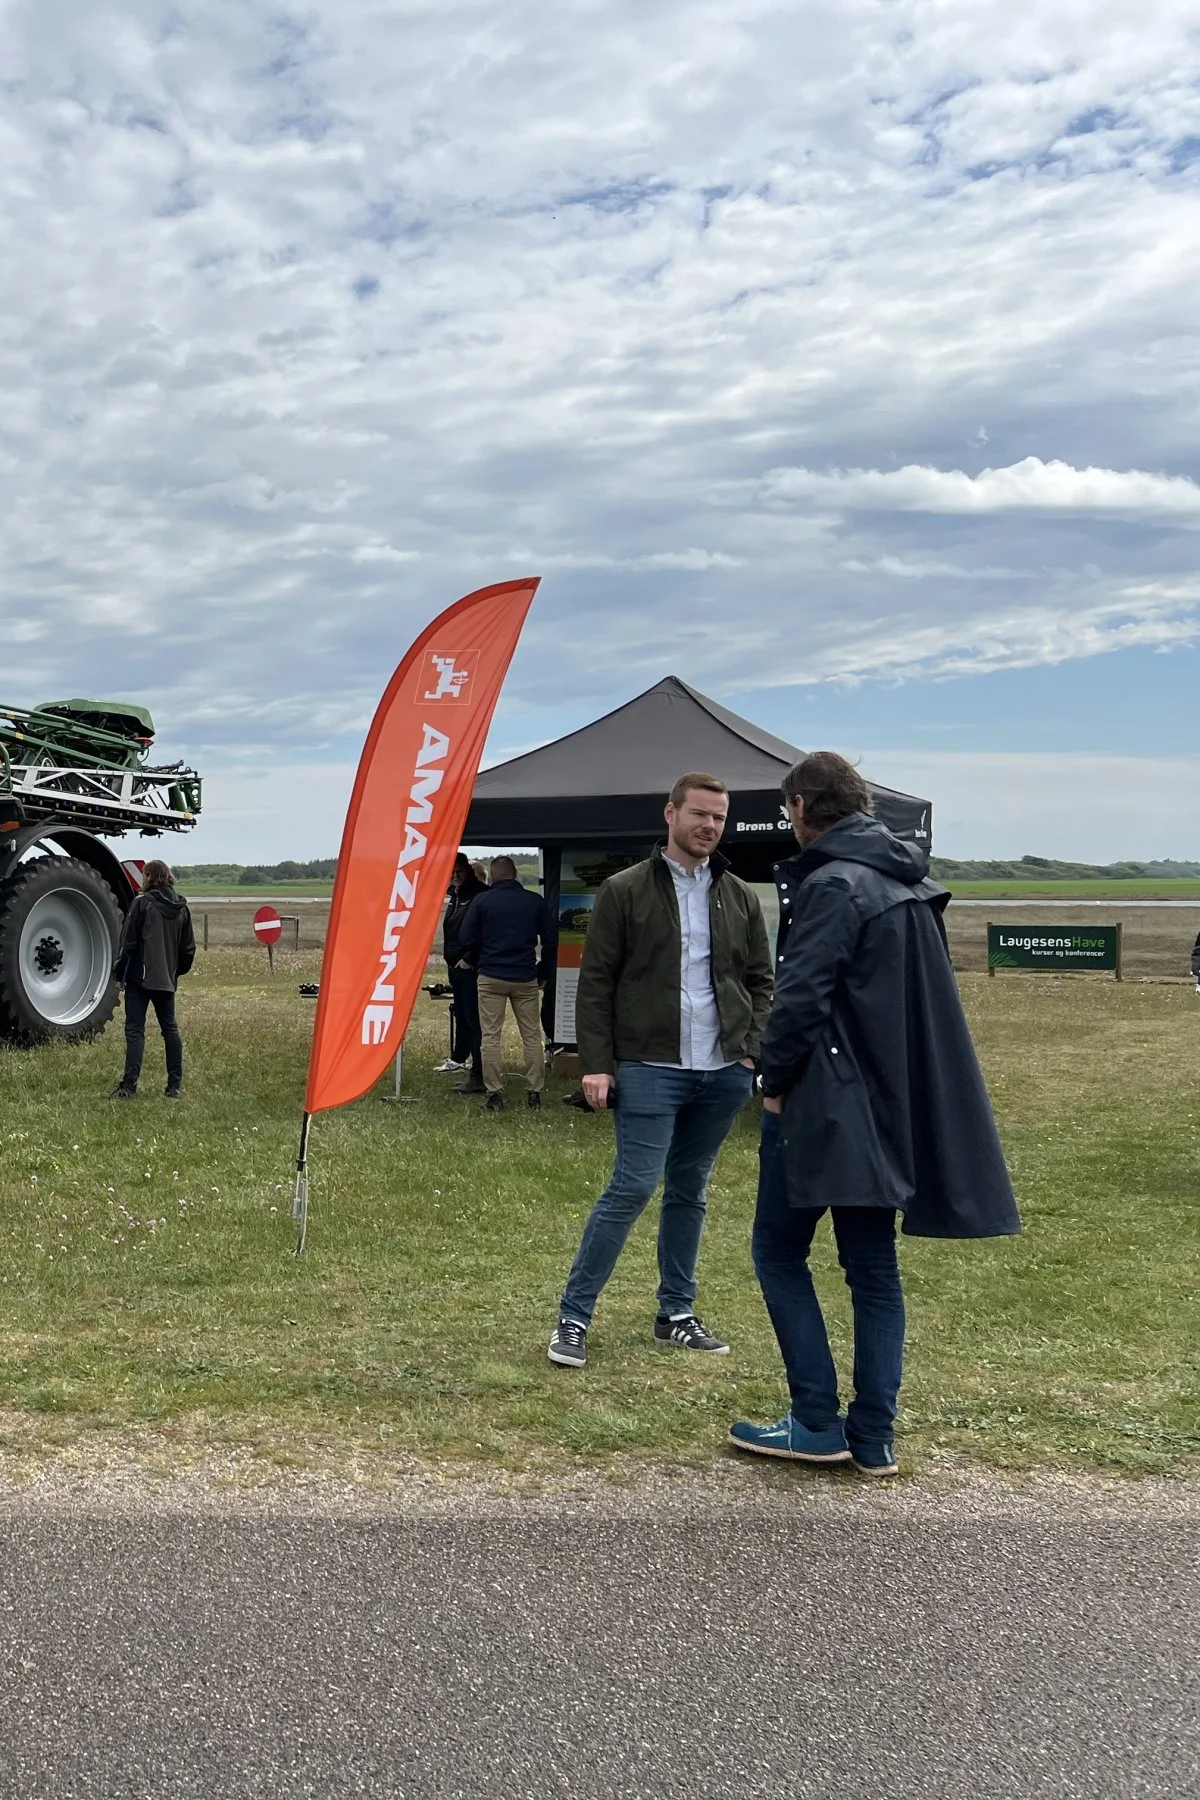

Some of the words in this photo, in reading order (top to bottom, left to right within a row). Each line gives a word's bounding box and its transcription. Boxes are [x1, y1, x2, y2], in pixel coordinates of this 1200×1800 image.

[736, 821, 774, 832] Brøns
[777, 819, 792, 830] Gr
[999, 934, 1106, 950] LaugesensHave
[1065, 949, 1106, 957] konferencer
